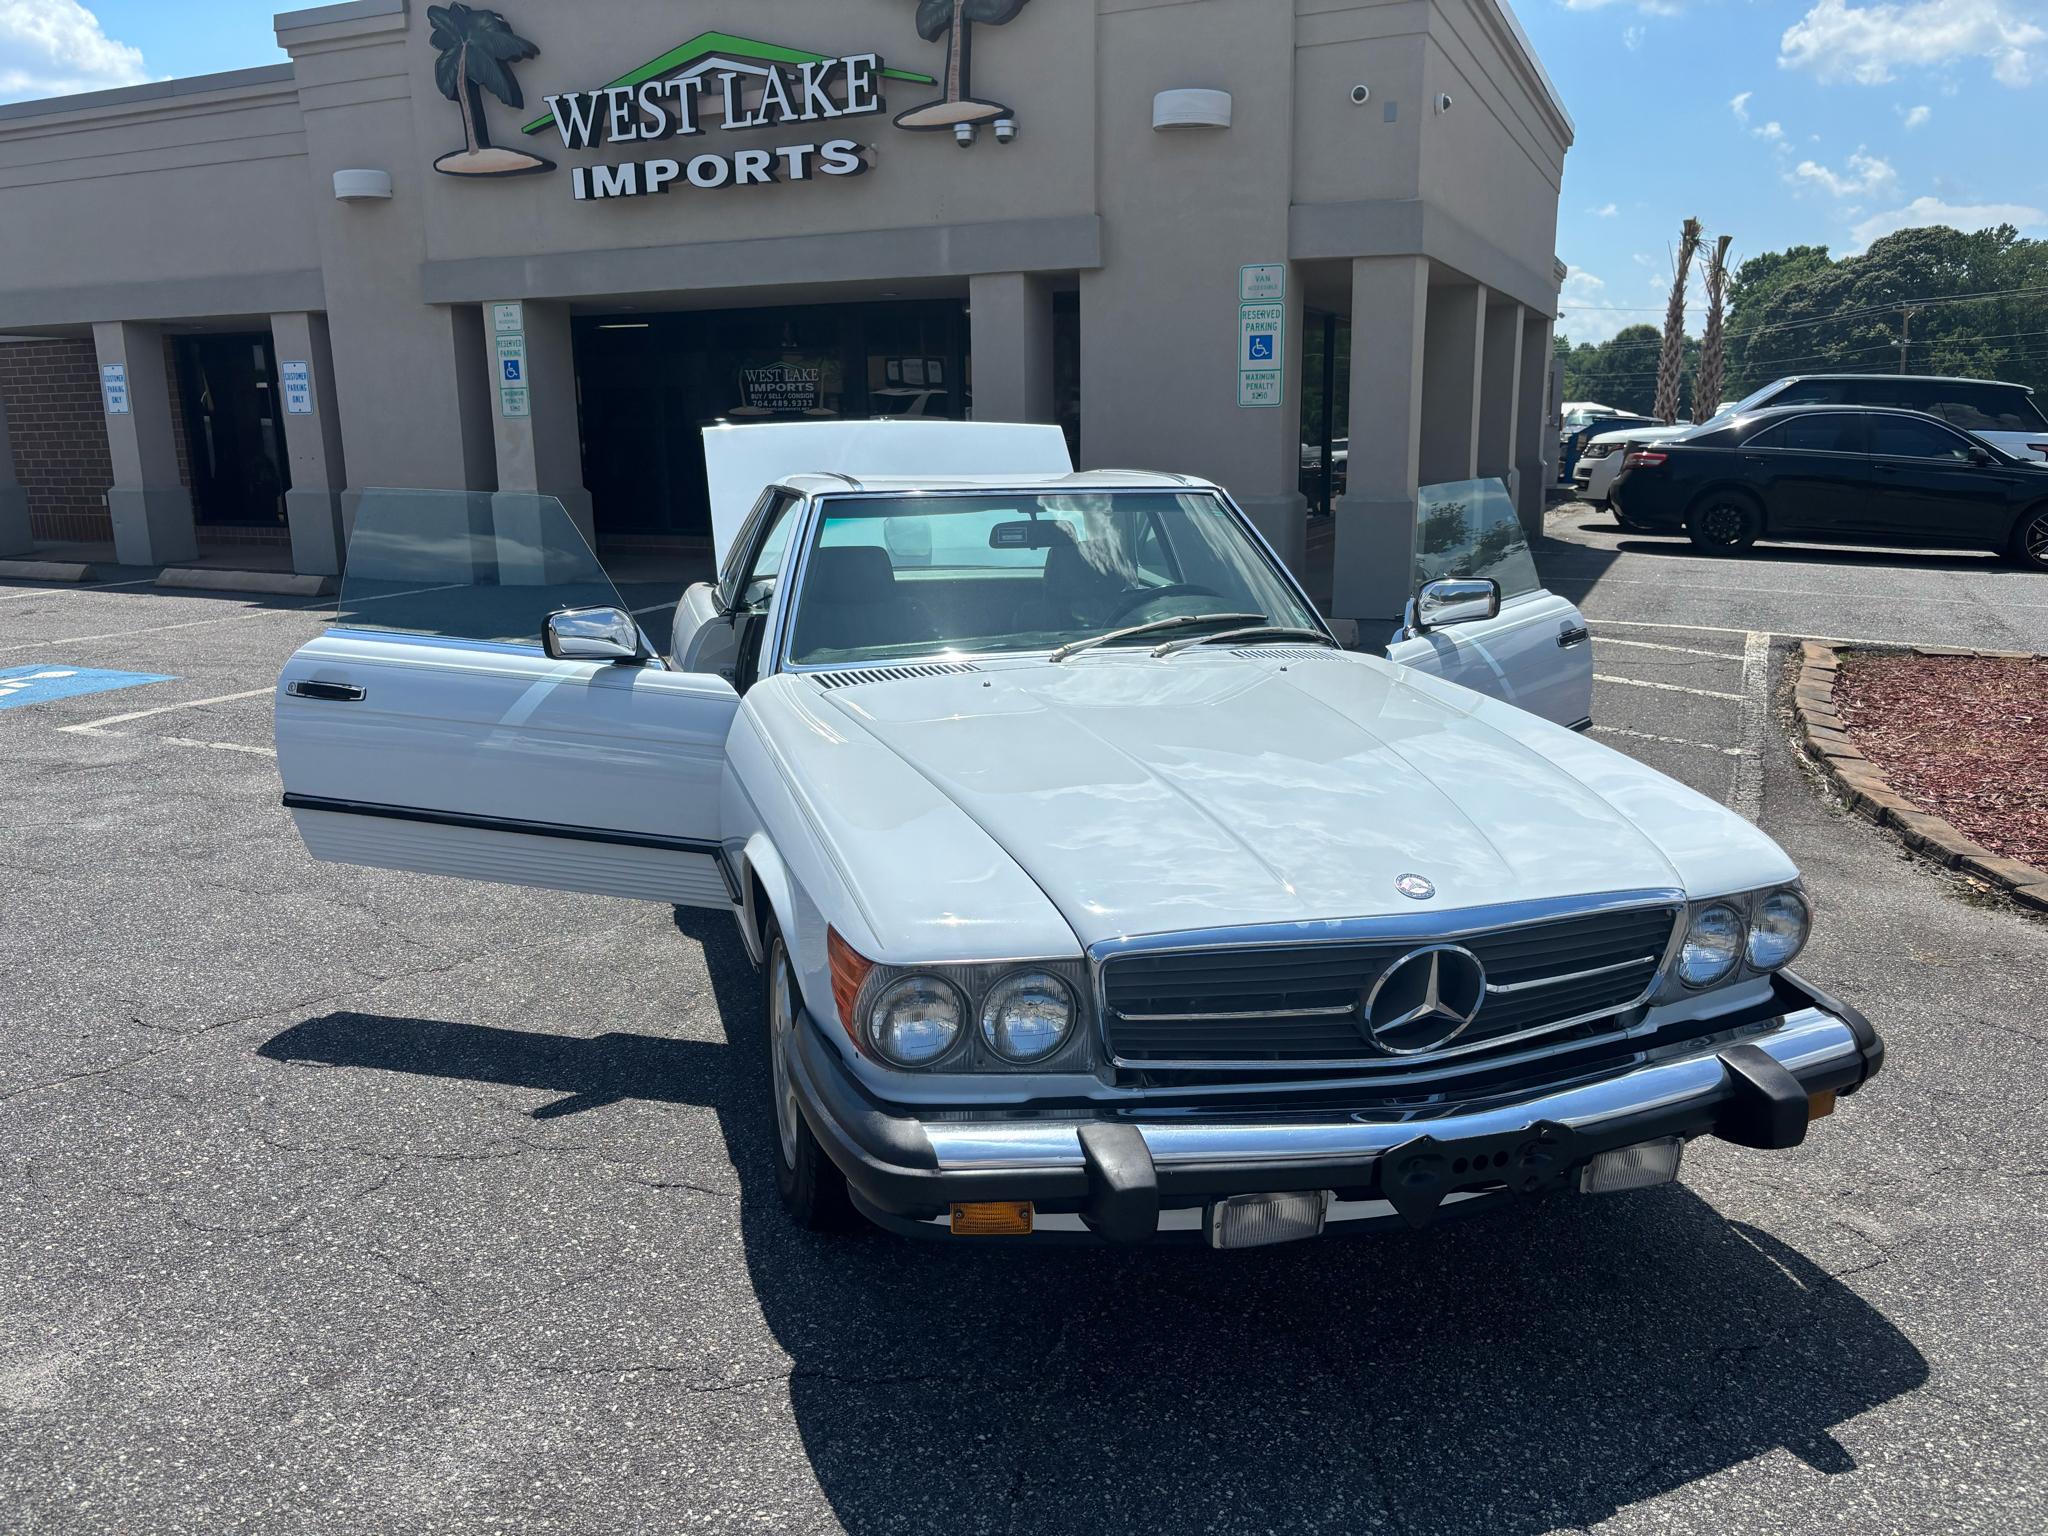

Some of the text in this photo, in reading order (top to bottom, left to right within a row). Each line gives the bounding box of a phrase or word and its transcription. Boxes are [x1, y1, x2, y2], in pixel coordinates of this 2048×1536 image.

[543, 52, 880, 150] WEST LAKE
[571, 139, 861, 201] IMPORTS
[1254, 274, 1271, 283] VAN
[1242, 309, 1281, 320] RESERVED
[1245, 322, 1278, 332] PARKING
[103, 375, 126, 383] CUSTOMER
[284, 373, 308, 381] CUSTOMER
[744, 368, 819, 382] WEST LAKE
[1245, 372, 1276, 381] MAXIMUM
[287, 383, 307, 392] PARKING
[749, 382, 815, 392] IMPORTS
[1245, 382, 1274, 391] PENALTY
[111, 396, 122, 404] ONLY
[292, 395, 304, 404] ONLY
[787, 392, 814, 400] CONSIGN
